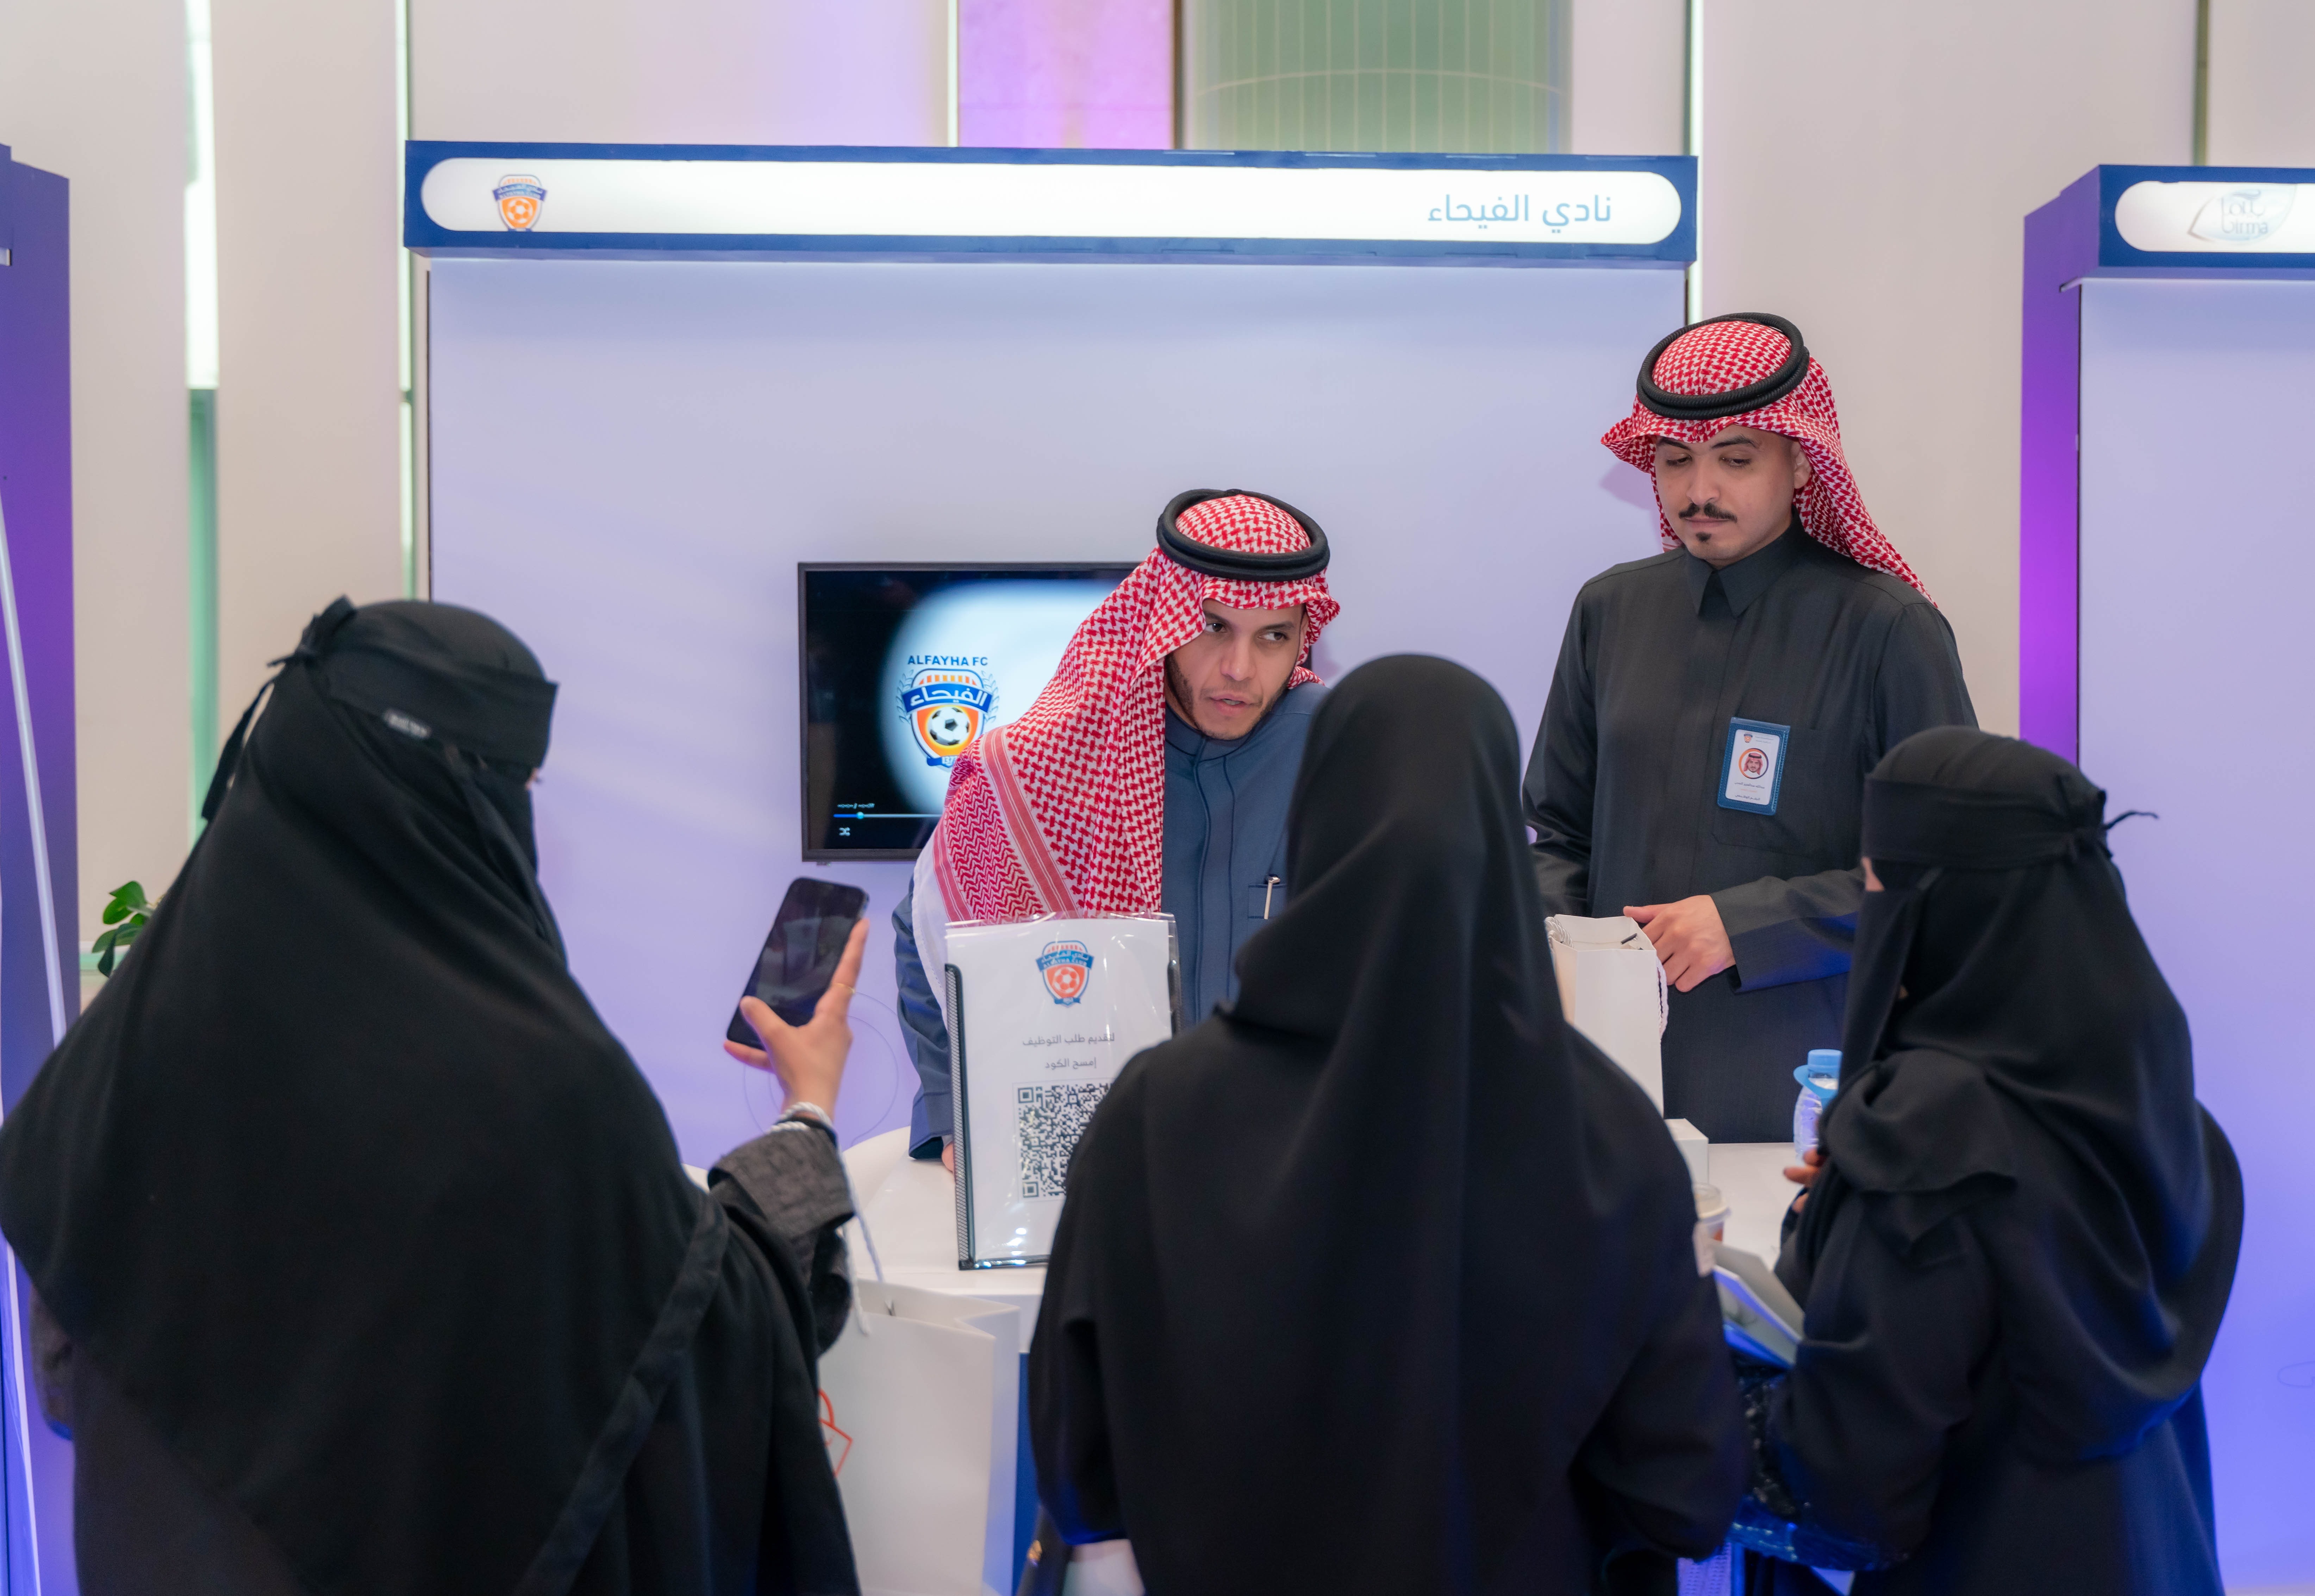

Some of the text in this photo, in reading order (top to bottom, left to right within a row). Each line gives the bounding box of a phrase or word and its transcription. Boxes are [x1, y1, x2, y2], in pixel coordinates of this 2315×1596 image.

[1428, 194, 1611, 233] نادي الفيحاء
[907, 655, 988, 666] ALFAYHA FC
[910, 687, 988, 706] الفيحاء
[1022, 1034, 1061, 1047] التوظيف
[1064, 1034, 1085, 1044] طلب
[1045, 1058, 1069, 1070] الكود
